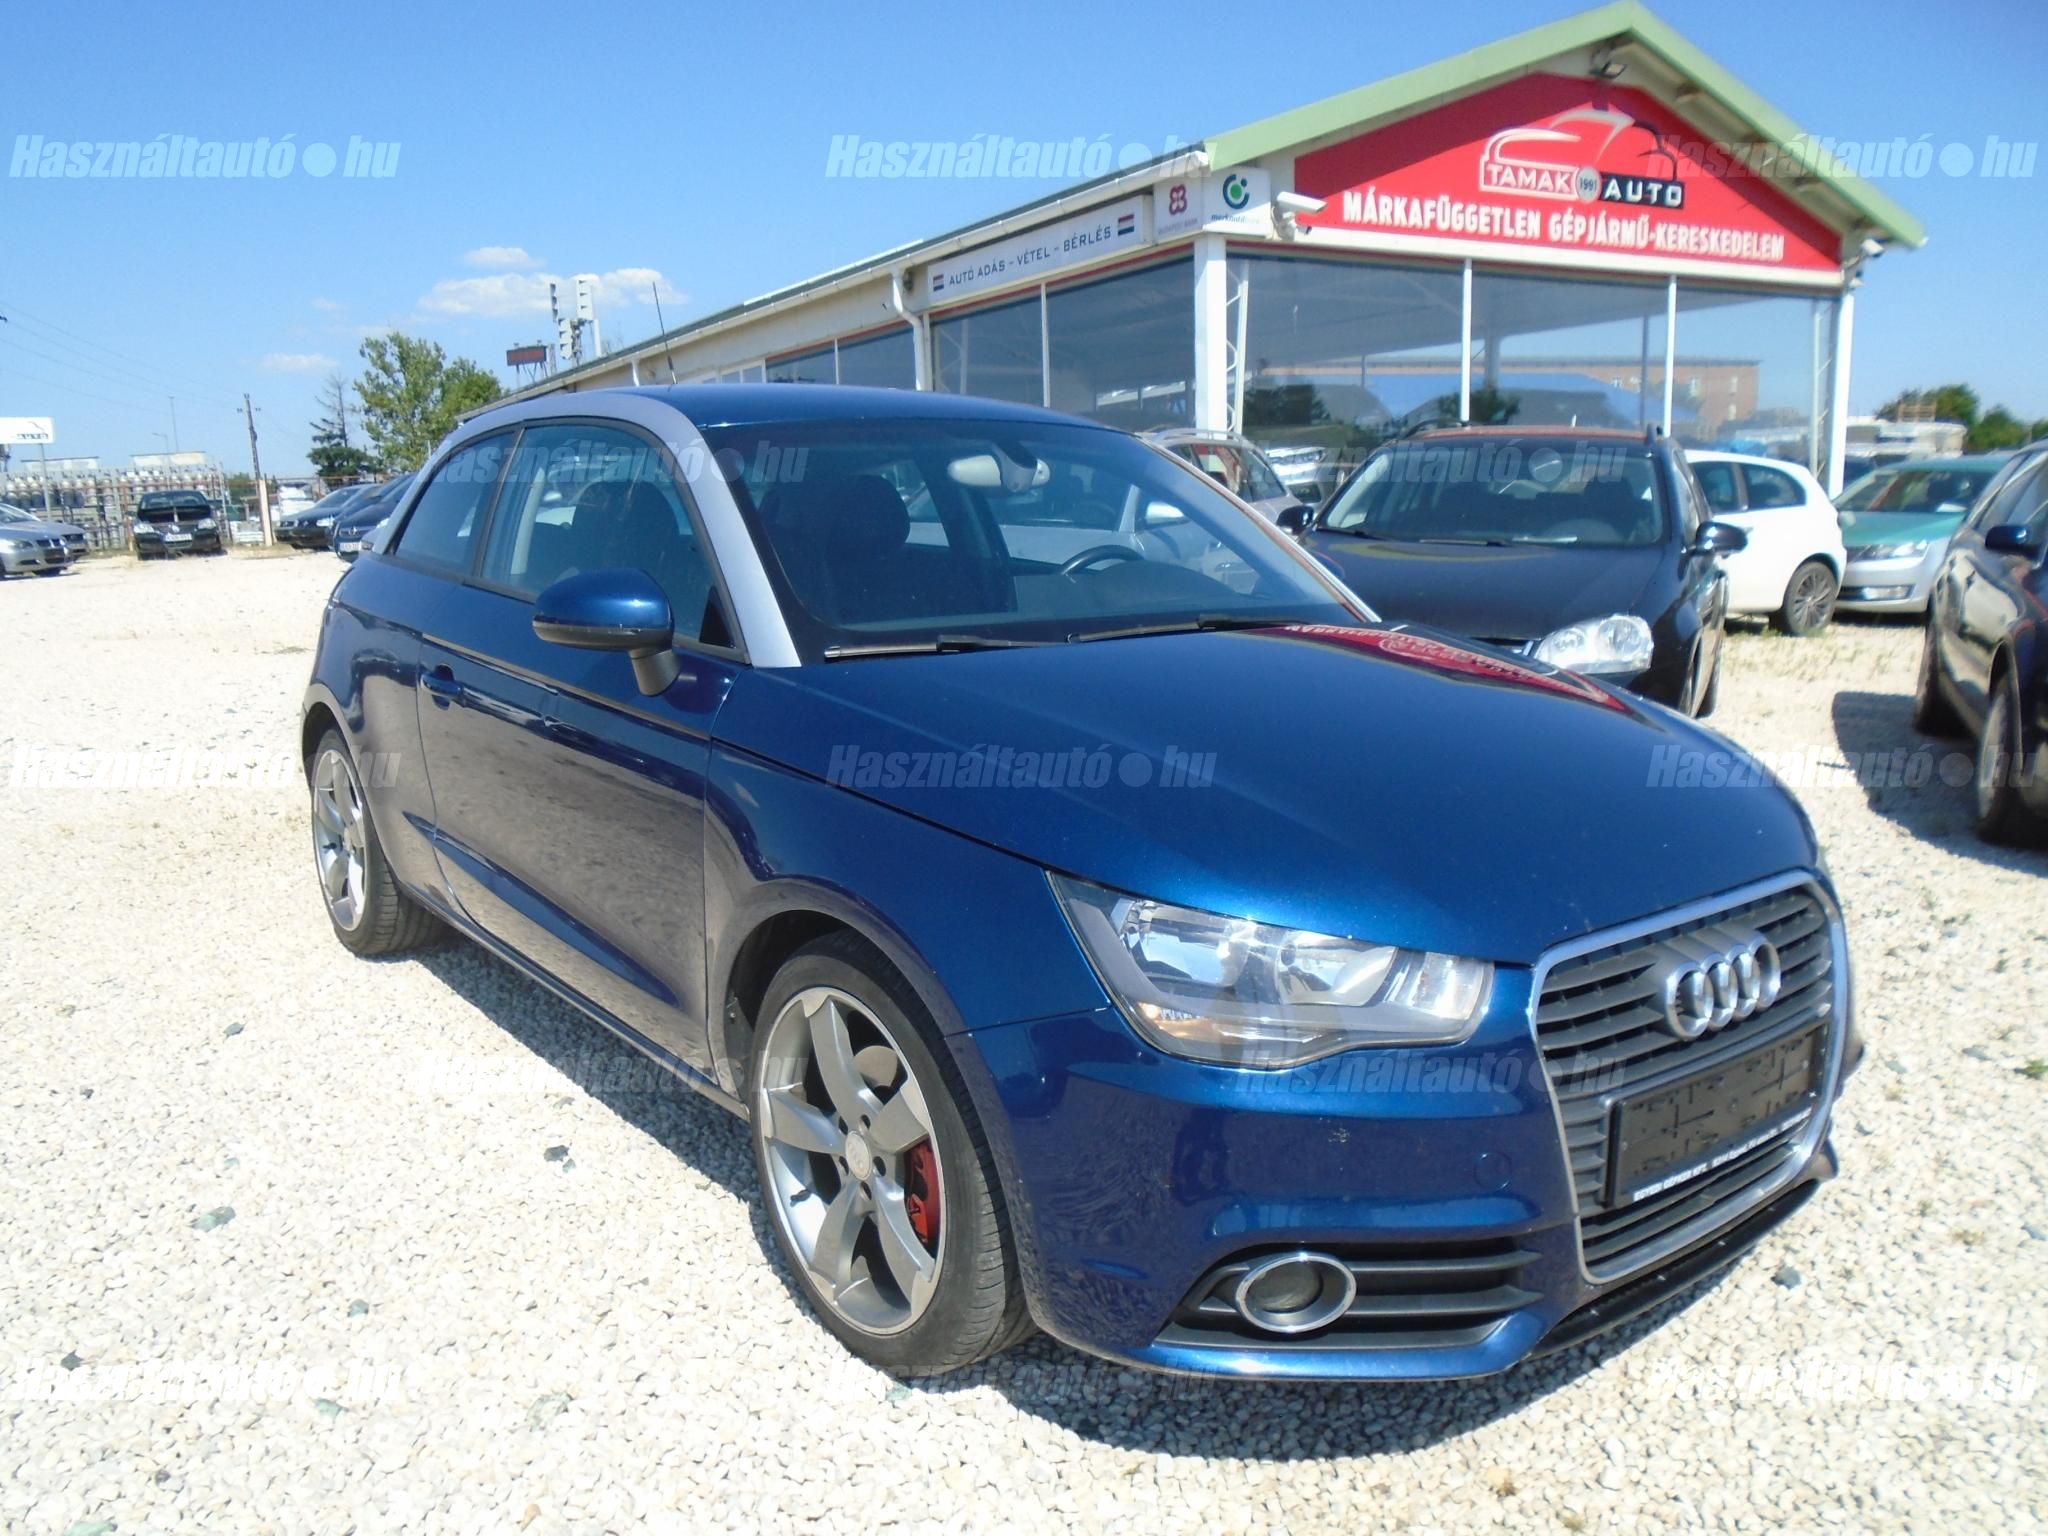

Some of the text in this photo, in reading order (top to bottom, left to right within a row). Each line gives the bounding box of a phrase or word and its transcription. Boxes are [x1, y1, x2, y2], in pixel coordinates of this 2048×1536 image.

[1487, 164, 1571, 195] TAMAK
[1604, 178, 1683, 208] AUTO
[1343, 186, 1786, 261] MÁRKAFÜGGETLEN GÉPJÁRMŰ-KERESKEDELEM
[949, 264, 974, 286] AUTÓ
[977, 256, 1005, 279] ADÁS
[1017, 246, 1050, 266] VÉTEL
[1063, 225, 1111, 252] BÉRLÉS
